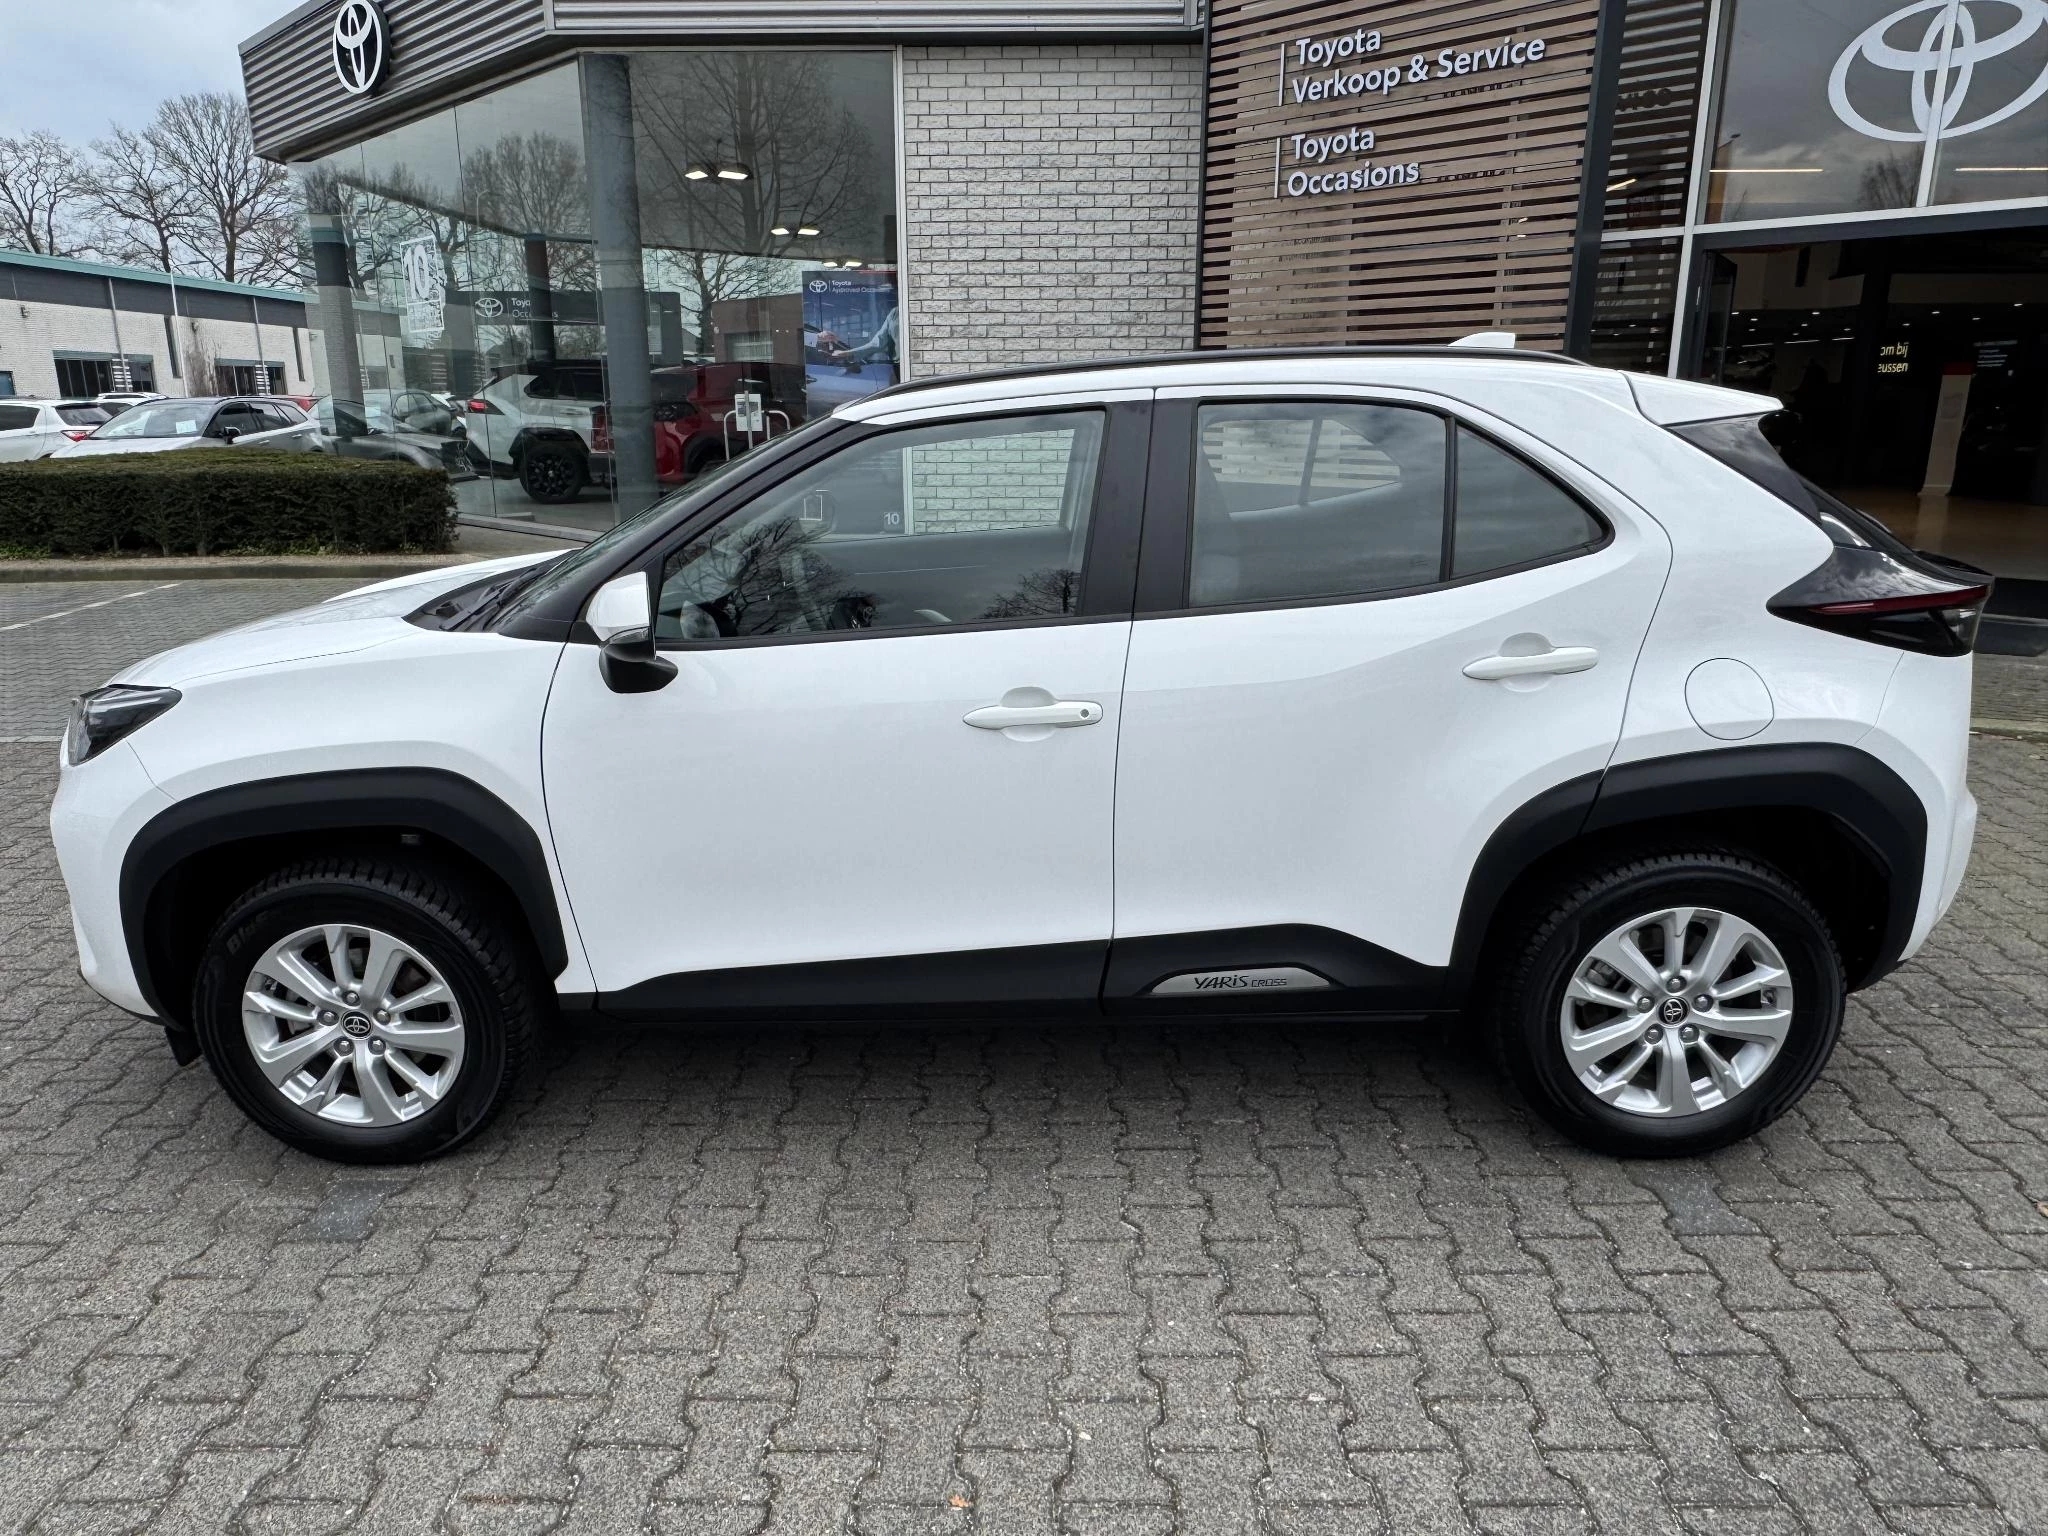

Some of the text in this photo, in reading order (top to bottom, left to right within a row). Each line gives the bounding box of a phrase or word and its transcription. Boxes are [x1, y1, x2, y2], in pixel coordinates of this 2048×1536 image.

[1296, 29, 1380, 68] Toyota
[1292, 36, 1545, 103] Verkoop & Service
[1291, 127, 1375, 163] Toyota
[1287, 161, 1419, 196] Occasions
[403, 244, 430, 301] 10
[884, 512, 900, 525] 10
[1251, 978, 1287, 988] CROSS
